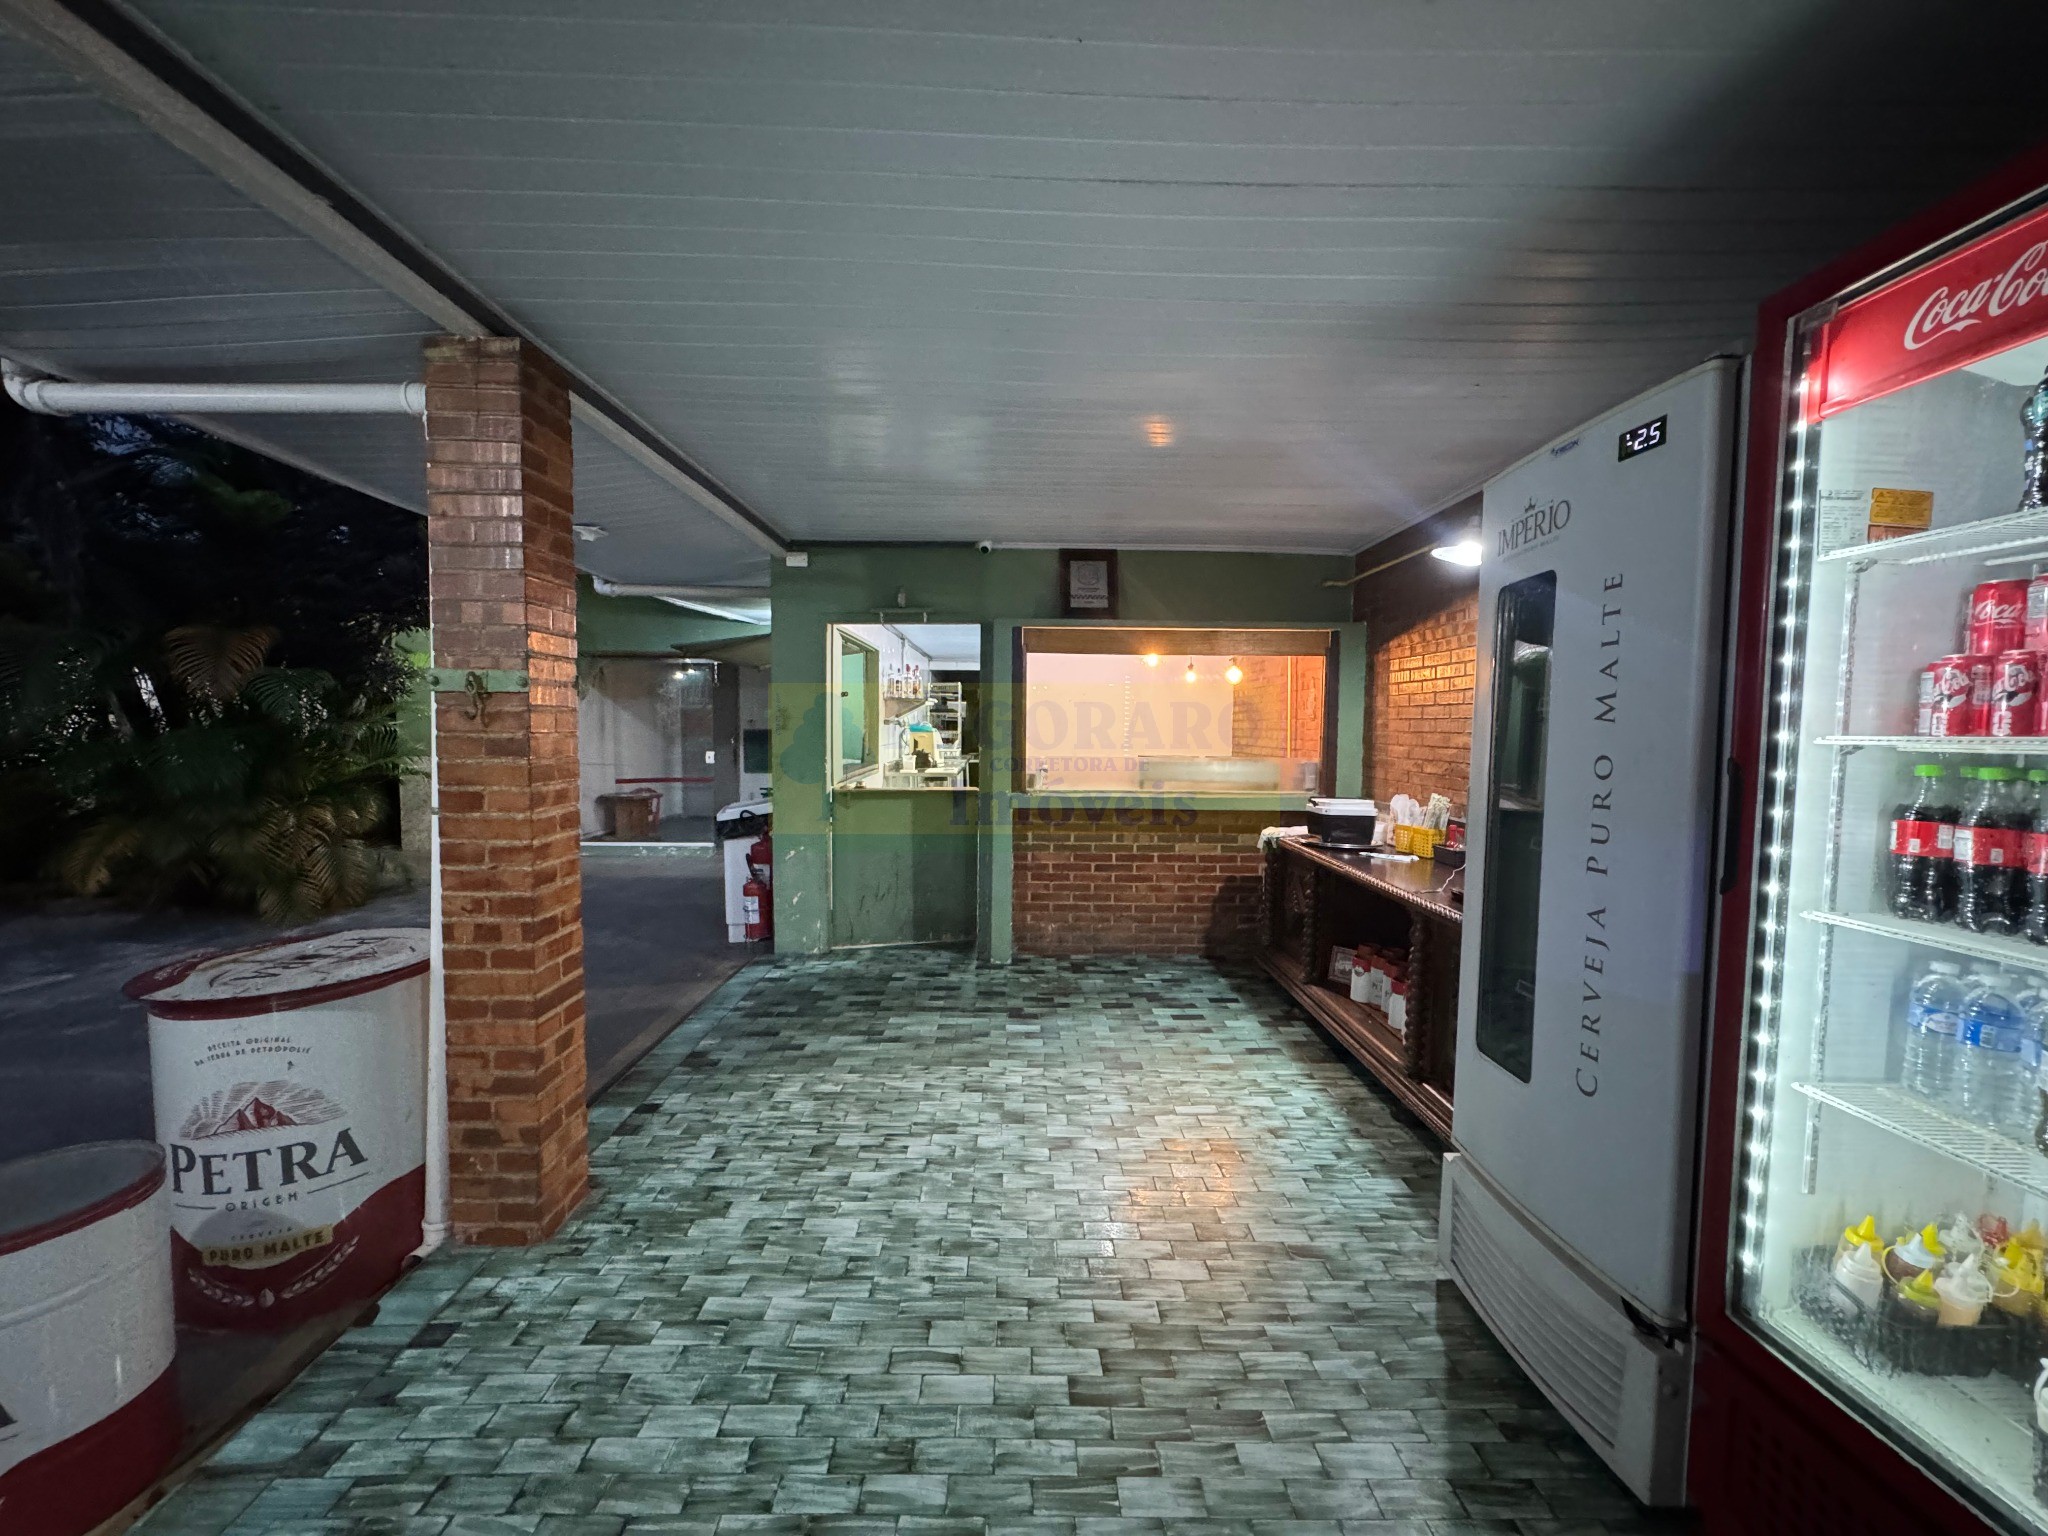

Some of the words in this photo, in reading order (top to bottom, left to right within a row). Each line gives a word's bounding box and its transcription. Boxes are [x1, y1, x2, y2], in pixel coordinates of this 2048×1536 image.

[1904, 240, 2048, 350] Coca-Co
[1594, 573, 1624, 723] MALTE
[1586, 755, 1615, 876] PURO
[1575, 906, 1611, 1098] CERVEJA
[235, 1048, 246, 1056] DE
[245, 1036, 291, 1045] ORIGINAL
[170, 1127, 369, 1195] PETRA
[225, 1192, 299, 1212] ORIGEM
[209, 1246, 252, 1263] PURO
[264, 1231, 325, 1254] MALTE
